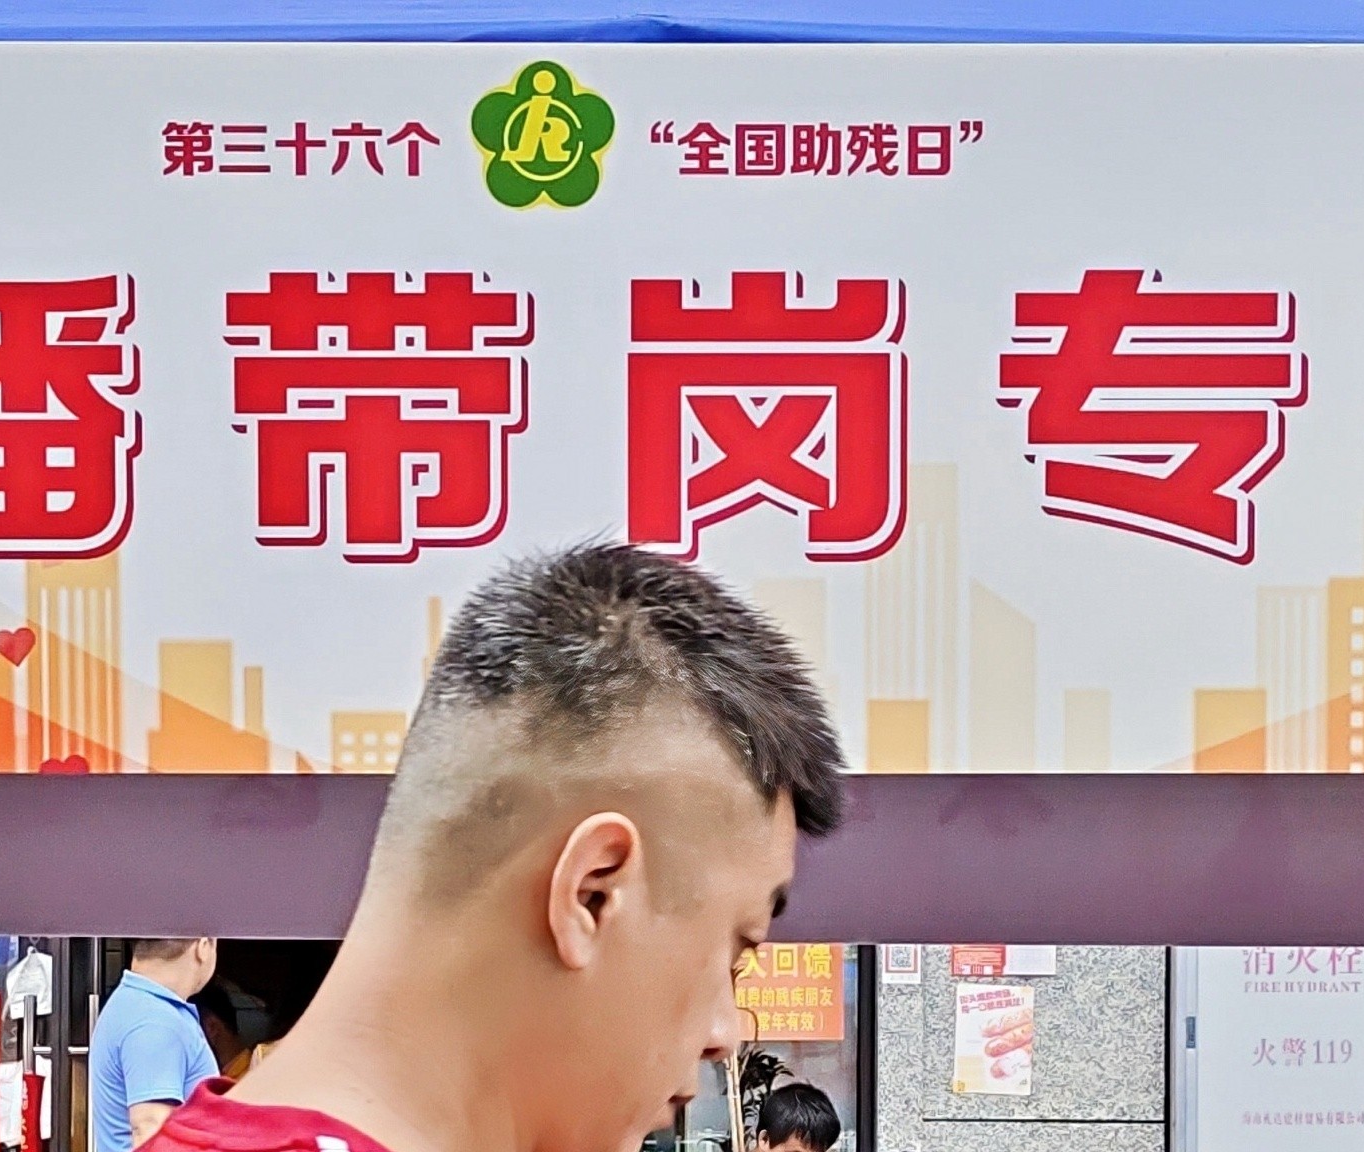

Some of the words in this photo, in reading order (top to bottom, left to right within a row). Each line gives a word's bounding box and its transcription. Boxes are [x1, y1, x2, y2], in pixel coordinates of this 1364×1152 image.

[161, 121, 440, 177] 第三十六个
[1243, 981, 1282, 993] FIRE
[1284, 981, 1362, 993] HYDRANT
[1252, 1038, 1353, 1067] 火警119
